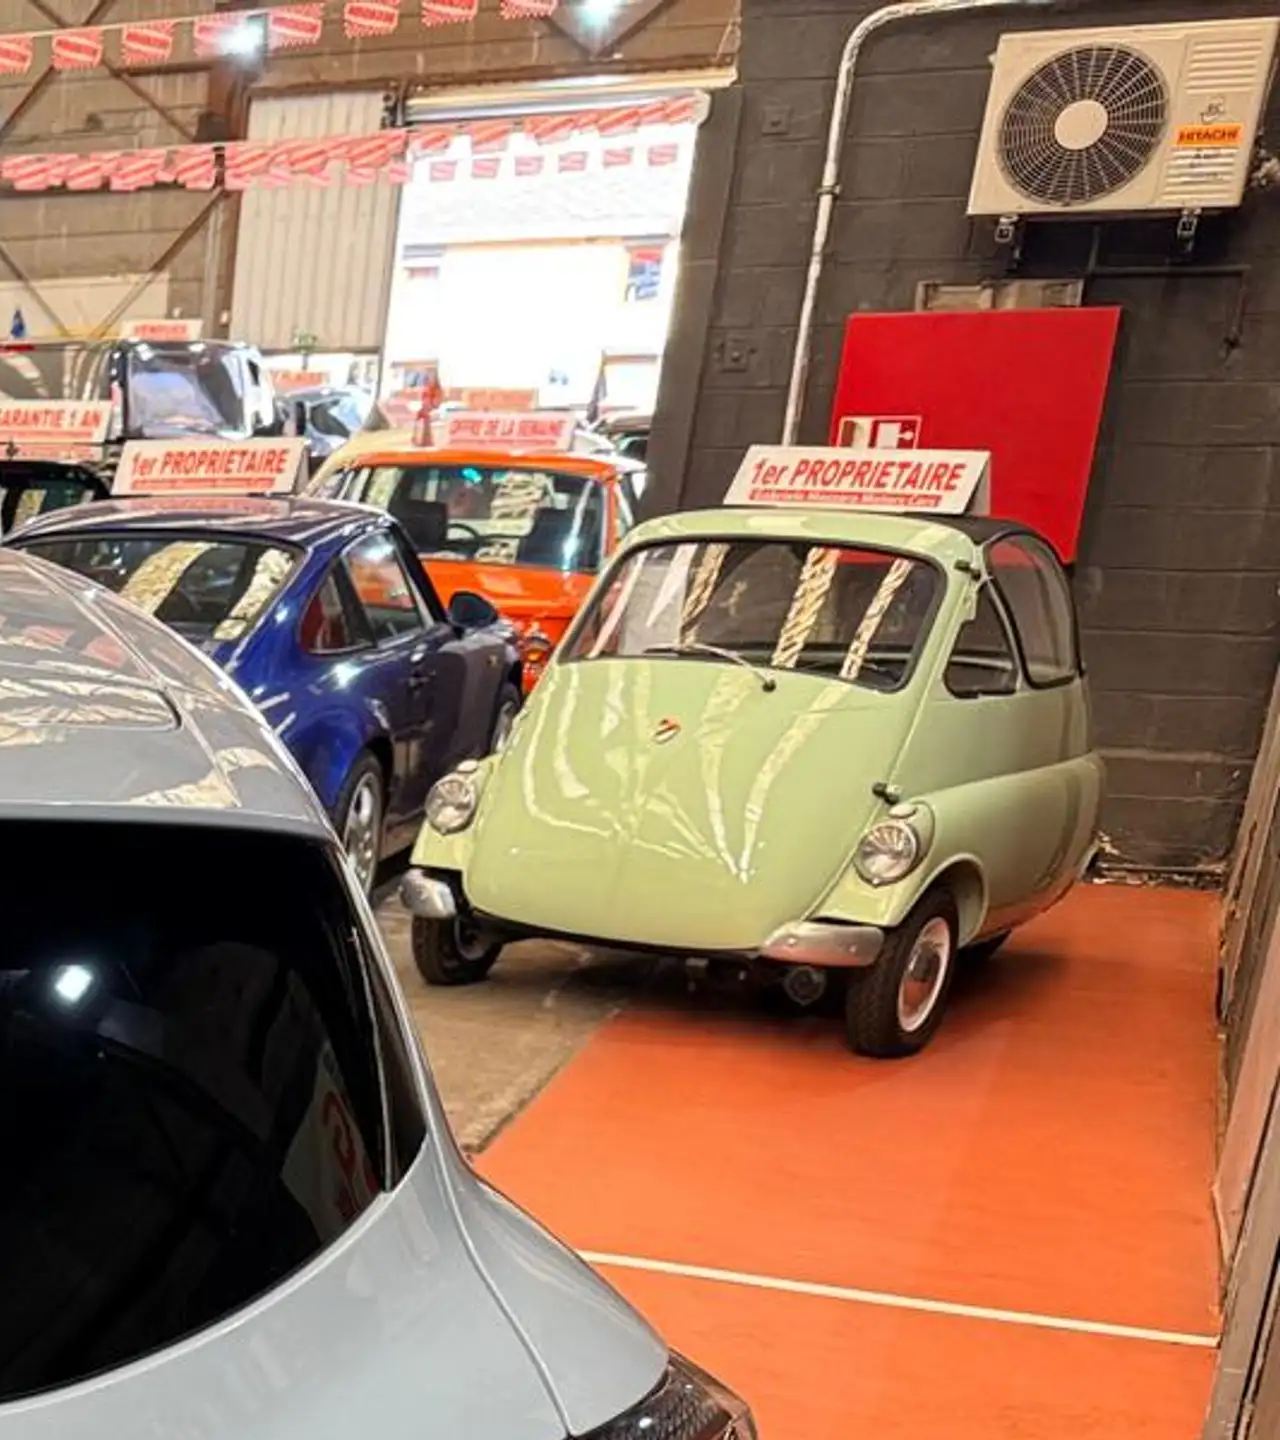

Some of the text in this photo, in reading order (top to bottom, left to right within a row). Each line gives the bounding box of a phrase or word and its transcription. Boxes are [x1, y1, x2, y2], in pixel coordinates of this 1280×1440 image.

[1179, 129, 1239, 141] HITACHI
[69, 409, 77, 426] 1
[80, 410, 102, 427] AN
[131, 448, 289, 476] 1er PROPRIETAIRE
[751, 458, 967, 492] 1er PROPRIETAIRE
